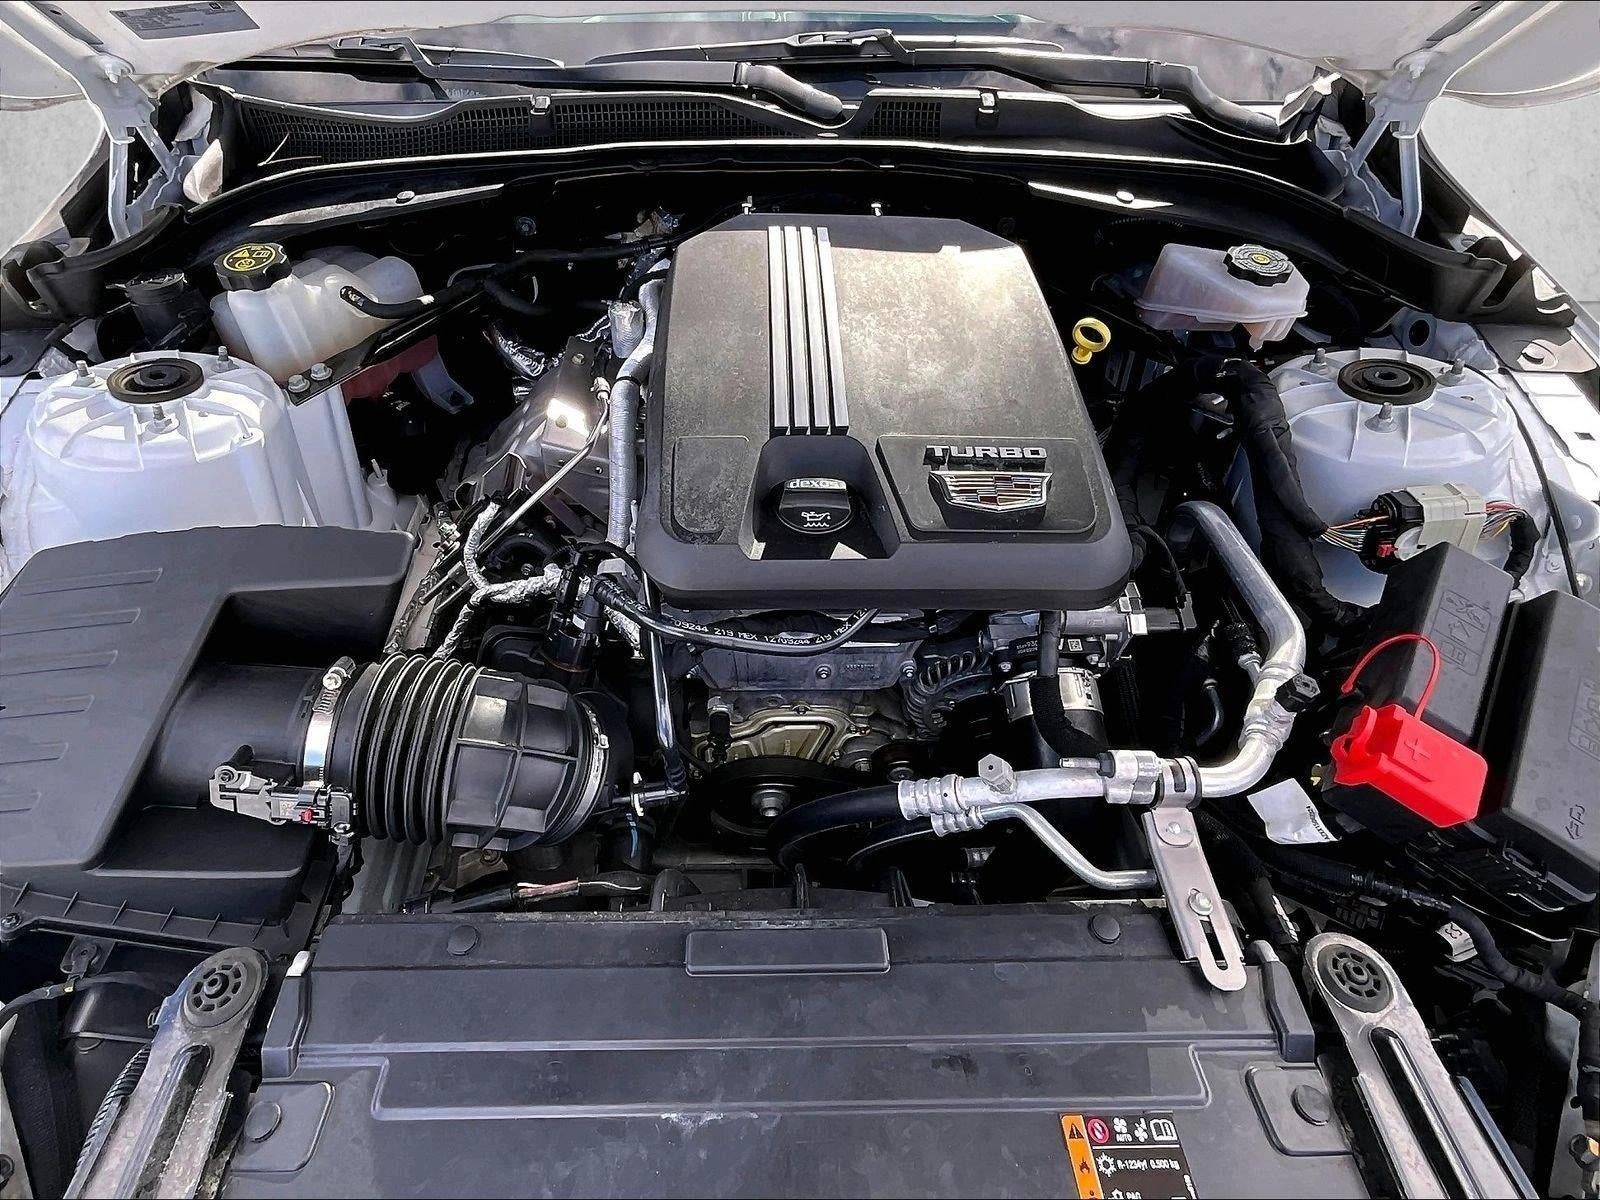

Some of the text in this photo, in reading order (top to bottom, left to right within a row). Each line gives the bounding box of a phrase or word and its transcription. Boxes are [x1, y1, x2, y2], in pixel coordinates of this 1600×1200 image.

[926, 445, 1047, 459] TURBO
[789, 478, 839, 489] dexos
[738, 630, 758, 641] MEX
[834, 621, 852, 636] MEX
